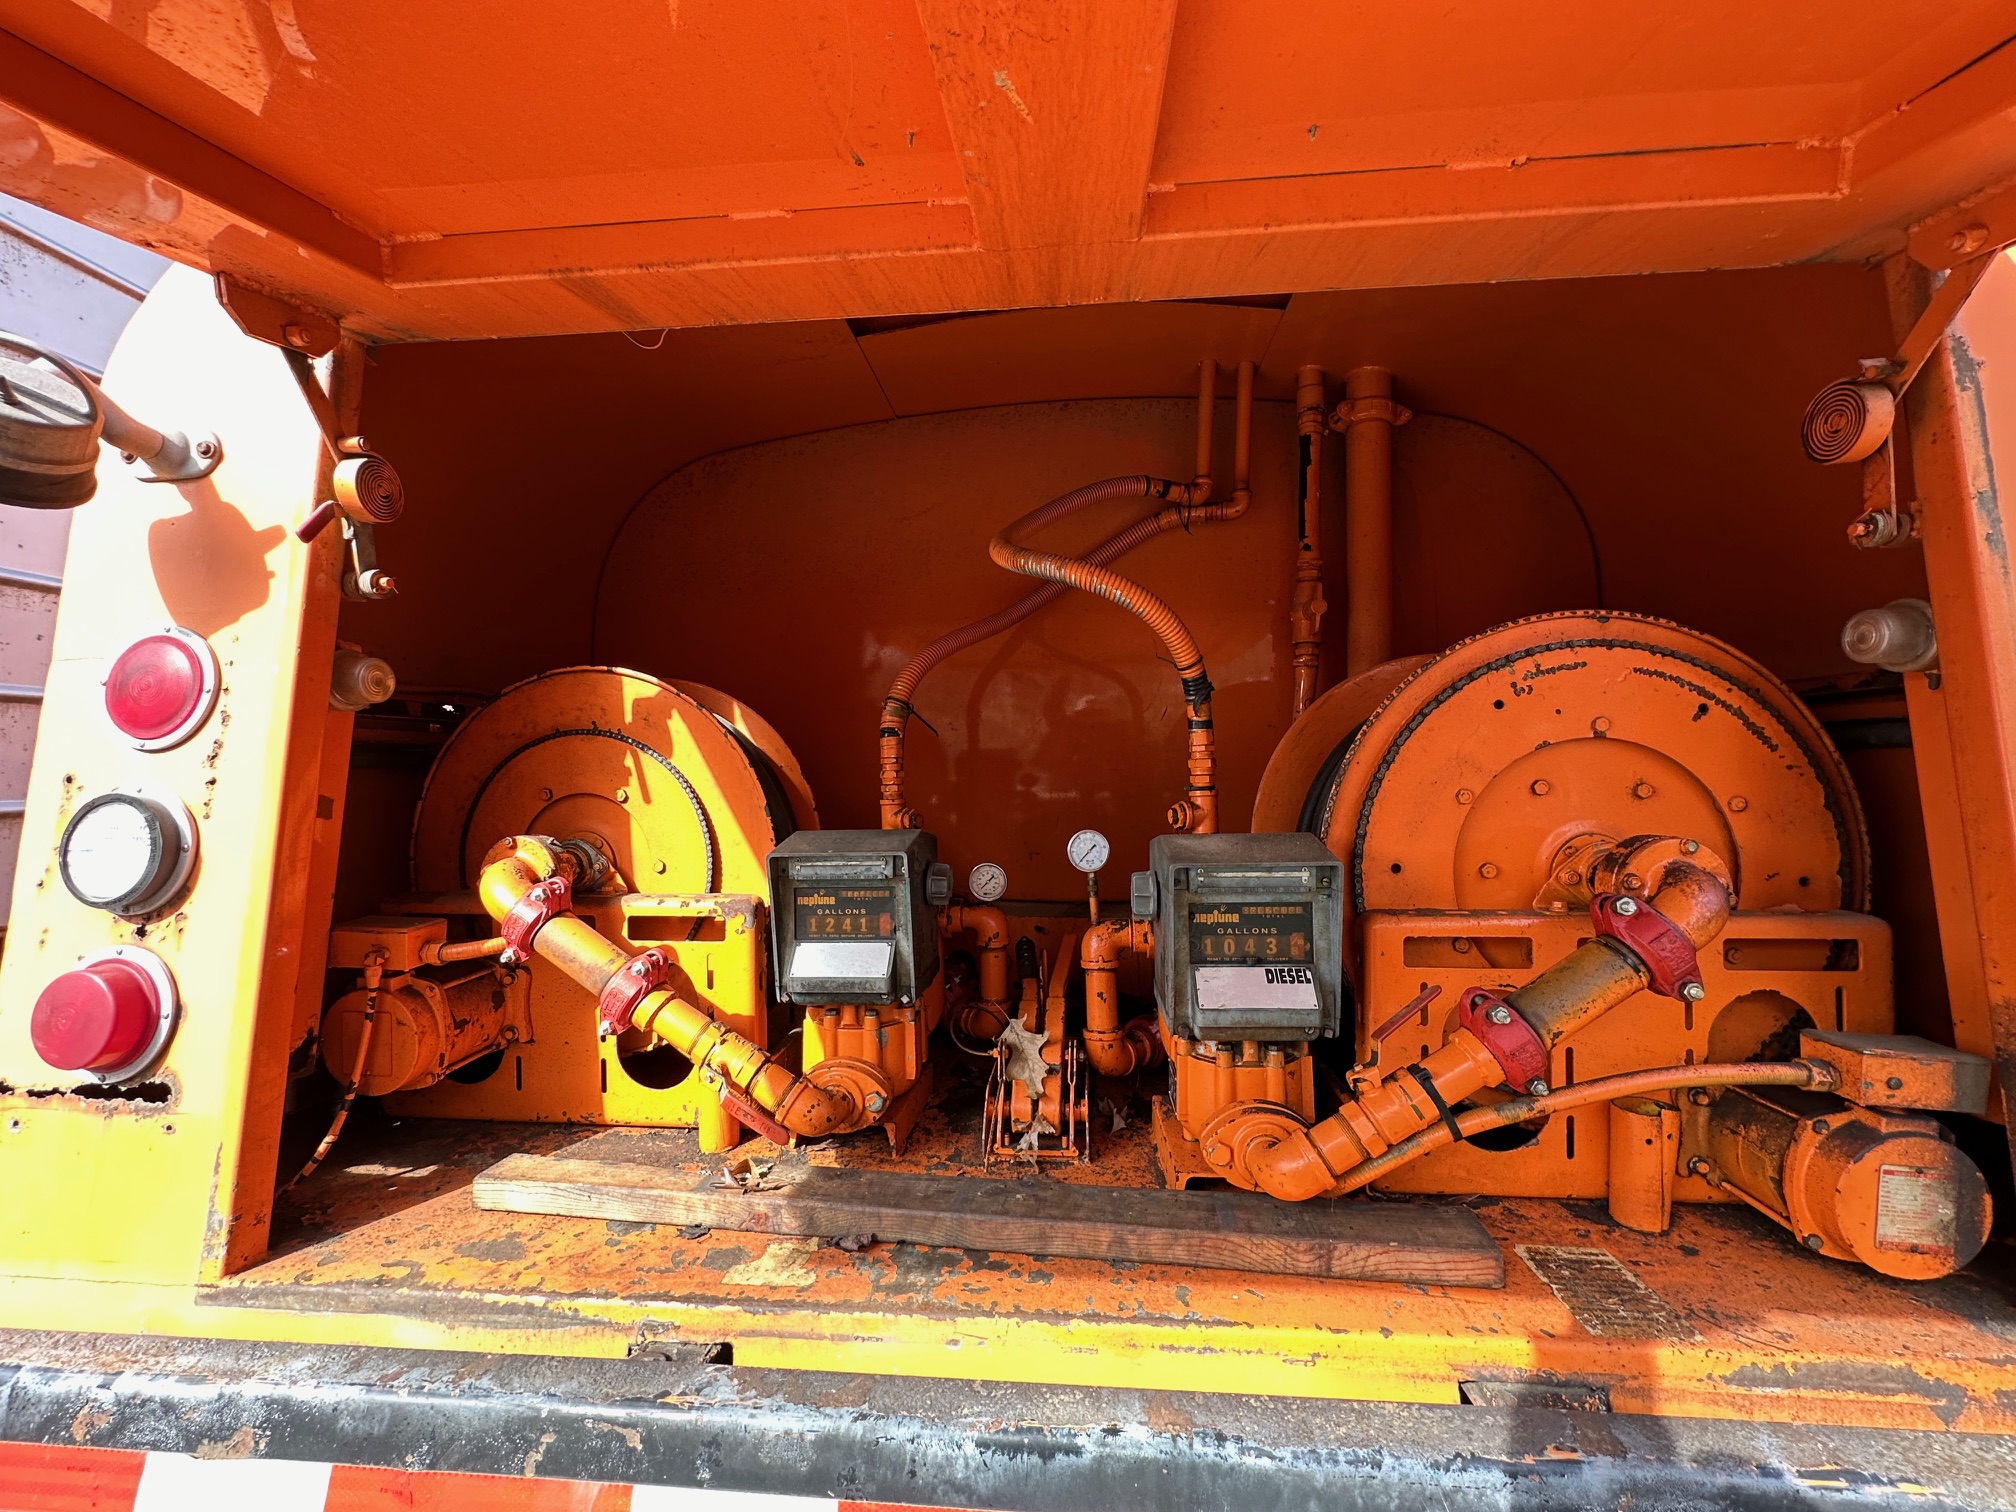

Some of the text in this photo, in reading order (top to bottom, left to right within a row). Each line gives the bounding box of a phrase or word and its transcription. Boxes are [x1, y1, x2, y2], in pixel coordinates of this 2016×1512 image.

[797, 893, 836, 907] neptune
[1193, 909, 1240, 925] neptune
[1217, 927, 1278, 935] GALLONS
[1264, 968, 1313, 984] DIESEL
